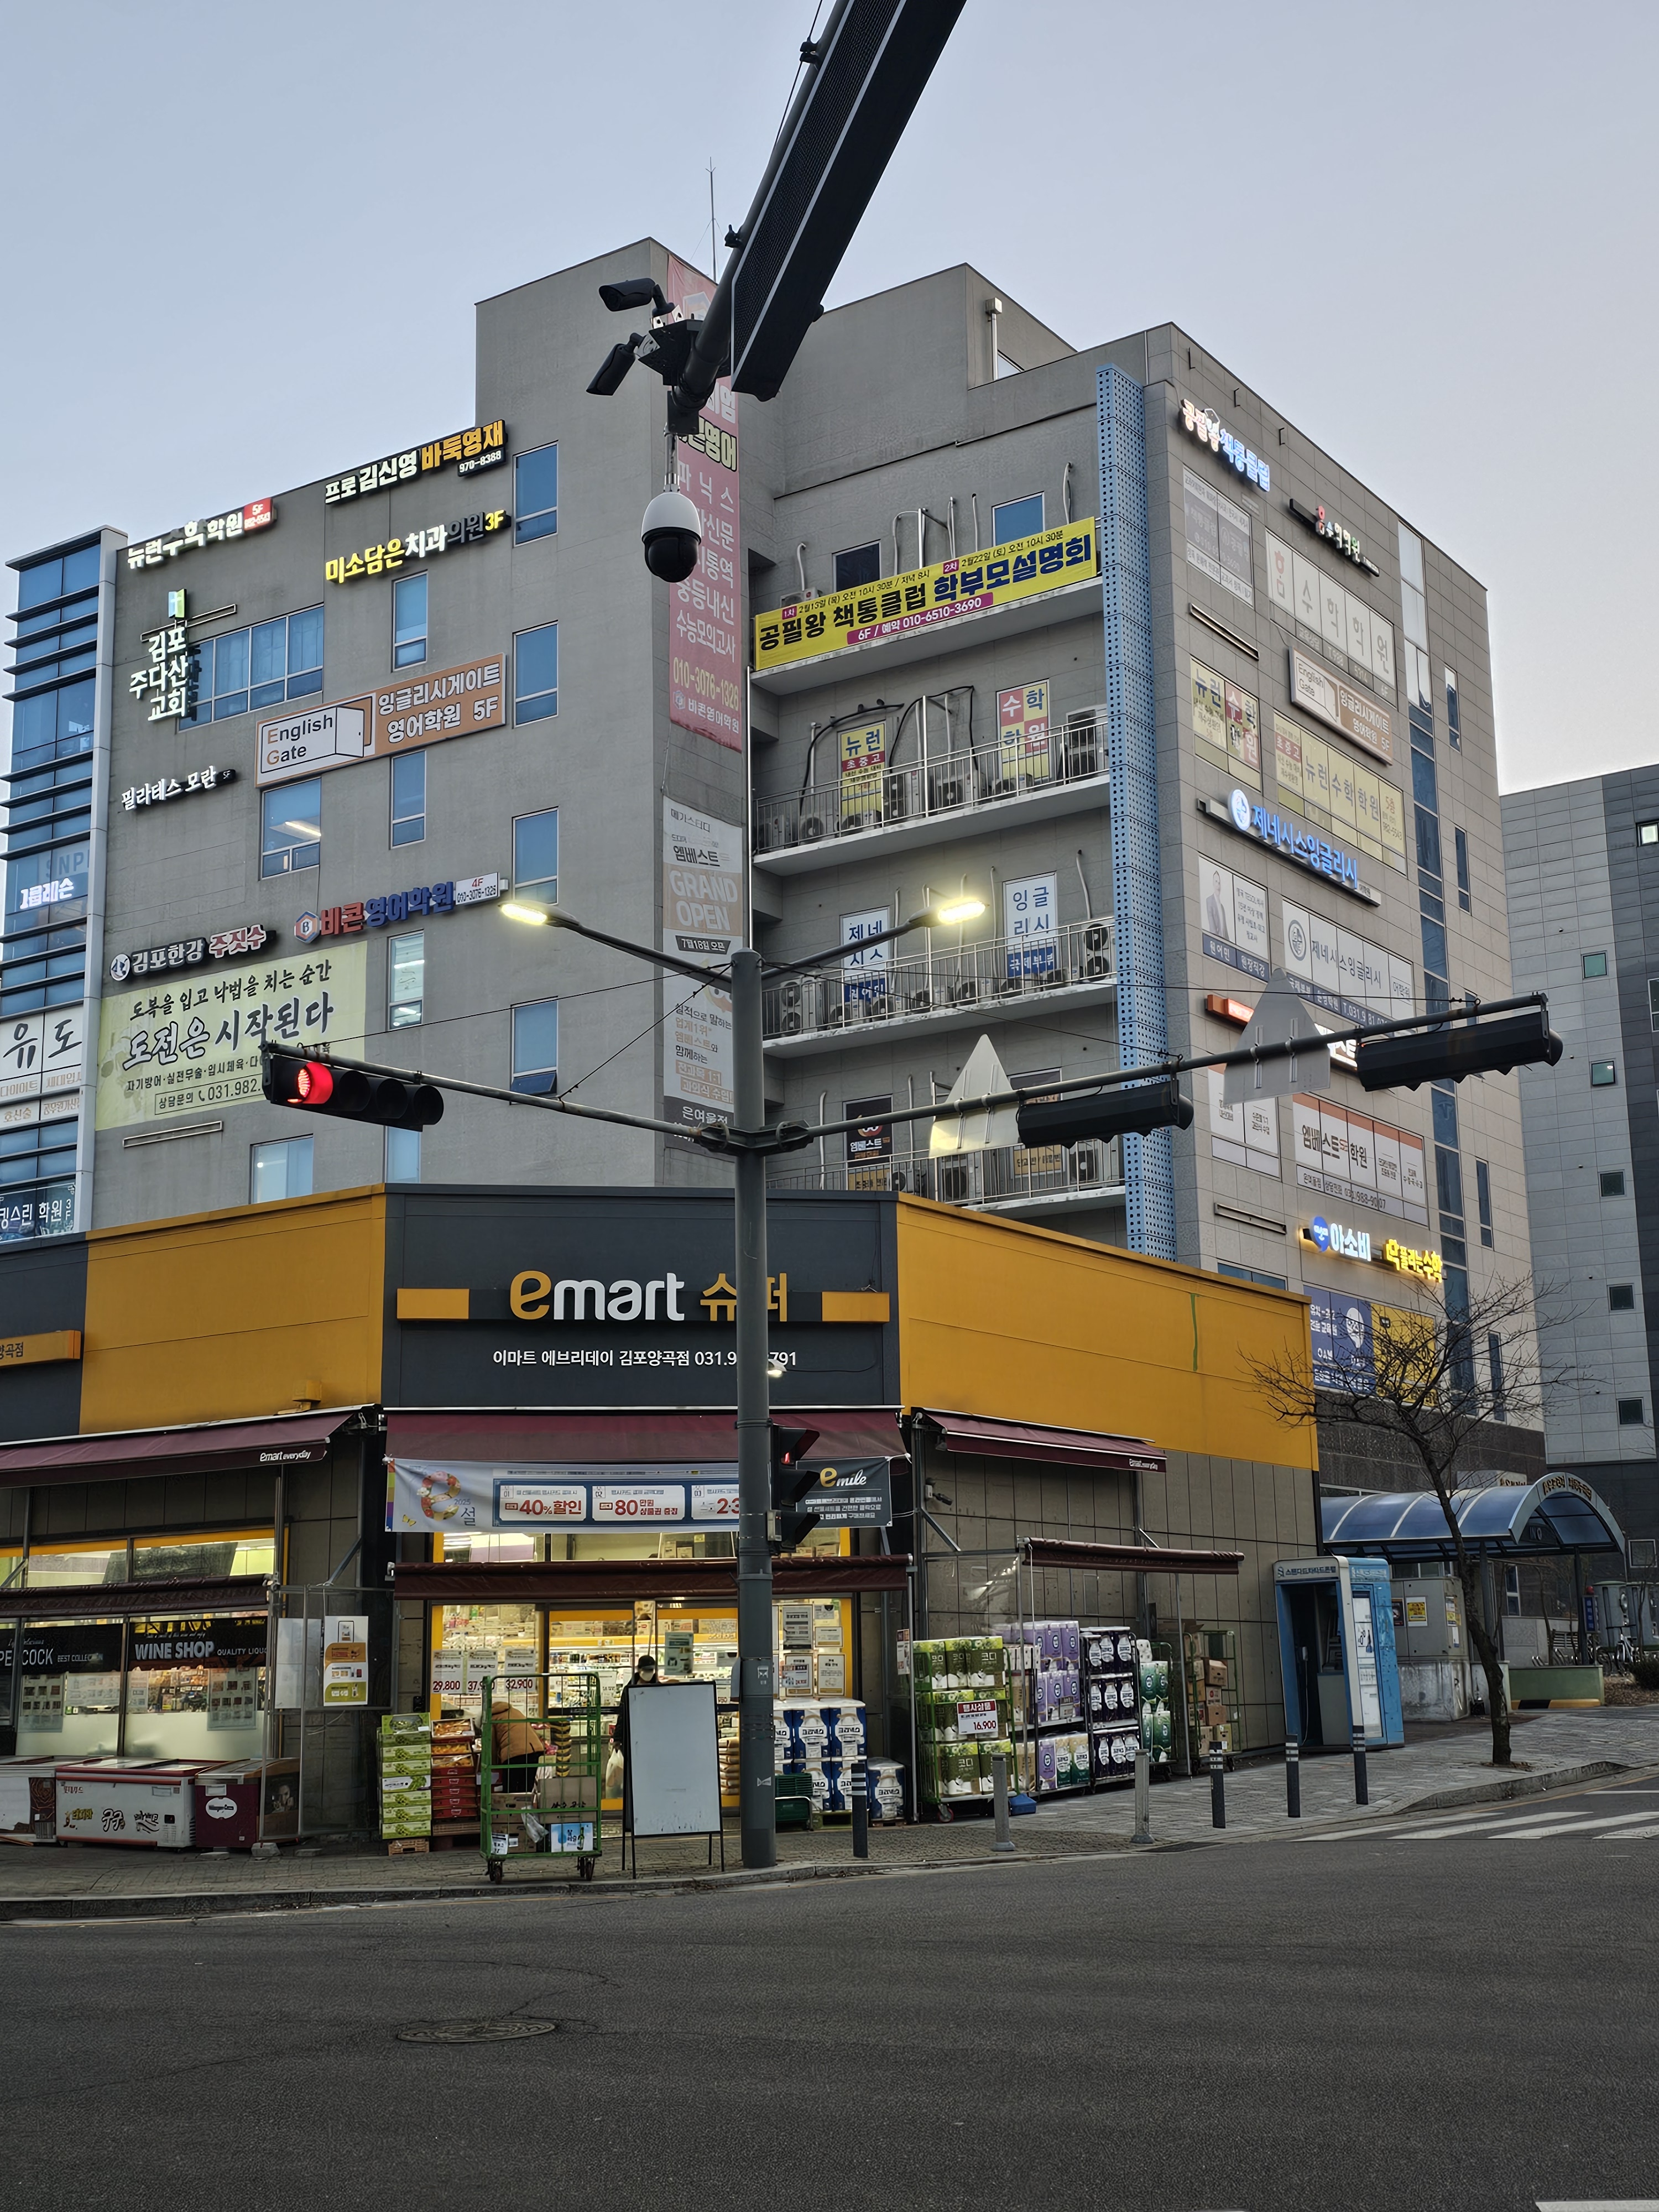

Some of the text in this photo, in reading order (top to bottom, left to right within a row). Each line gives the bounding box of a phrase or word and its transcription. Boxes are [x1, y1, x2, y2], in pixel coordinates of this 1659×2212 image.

[422, 420, 503, 471] 바둑영재
[460, 450, 502, 473] 970-8388
[1009, 542, 1024, 554] 오전
[1026, 535, 1043, 548] 10시
[1045, 530, 1063, 542] 30분
[760, 534, 1091, 650] 공필왕 책통클럽 학부모설명회
[842, 591, 856, 602] 오전
[859, 585, 875, 596] 10시
[901, 573, 915, 584] 저녁
[676, 609, 735, 662] 수능모의고사
[858, 598, 982, 640] 6F 예약 010-6510-3690
[149, 627, 186, 662] 김포
[129, 655, 189, 699] 주다산
[378, 662, 501, 716] 잉글리시게이트
[672, 656, 739, 711] 010-3076-1326
[1298, 663, 1323, 688] English
[148, 687, 186, 721] 교회
[387, 696, 499, 743] 영어학원 5F
[1340, 690, 1390, 735] 잉글리시게이트
[268, 714, 333, 745] English
[846, 729, 880, 757] 뉴런
[267, 744, 307, 766] Gate
[122, 778, 181, 810] 필라테스
[185, 765, 217, 789] 모란
[671, 808, 710, 832] 메가스터디
[46, 850, 90, 878] SNP
[1253, 805, 1358, 889] 제네시스잉글리시
[472, 878, 484, 888] 4F
[669, 870, 738, 902] GRAND
[676, 900, 731, 931] OPEN
[132, 924, 268, 973] 김포한강 주짓수
[1311, 940, 1382, 989] 제네시스잉글리시
[130, 959, 332, 1021] 도복을 입고 낙법을 치는 순간
[3, 1019, 82, 1070] 유도
[123, 992, 334, 1071] 도전은 시작된다
[676, 1045, 708, 1064] 함께하는
[159, 1077, 262, 1109] 상담문의 031.982.
[39, 1199, 62, 1223] 학원
[1330, 1223, 1371, 1261] 아소비
[510, 1270, 685, 1321] emart
[493, 1350, 537, 1366] 이마트
[541, 1350, 613, 1366] 에브리데이
[619, 1350, 690, 1366] 김포양곡점
[461, 1506, 476, 1526] 설
[0, 1648, 54, 1666] PECOCK
[135, 1642, 173, 1660] WINE
[175, 1641, 215, 1659] SHOP
[217, 1648, 246, 1656] QUALITY
